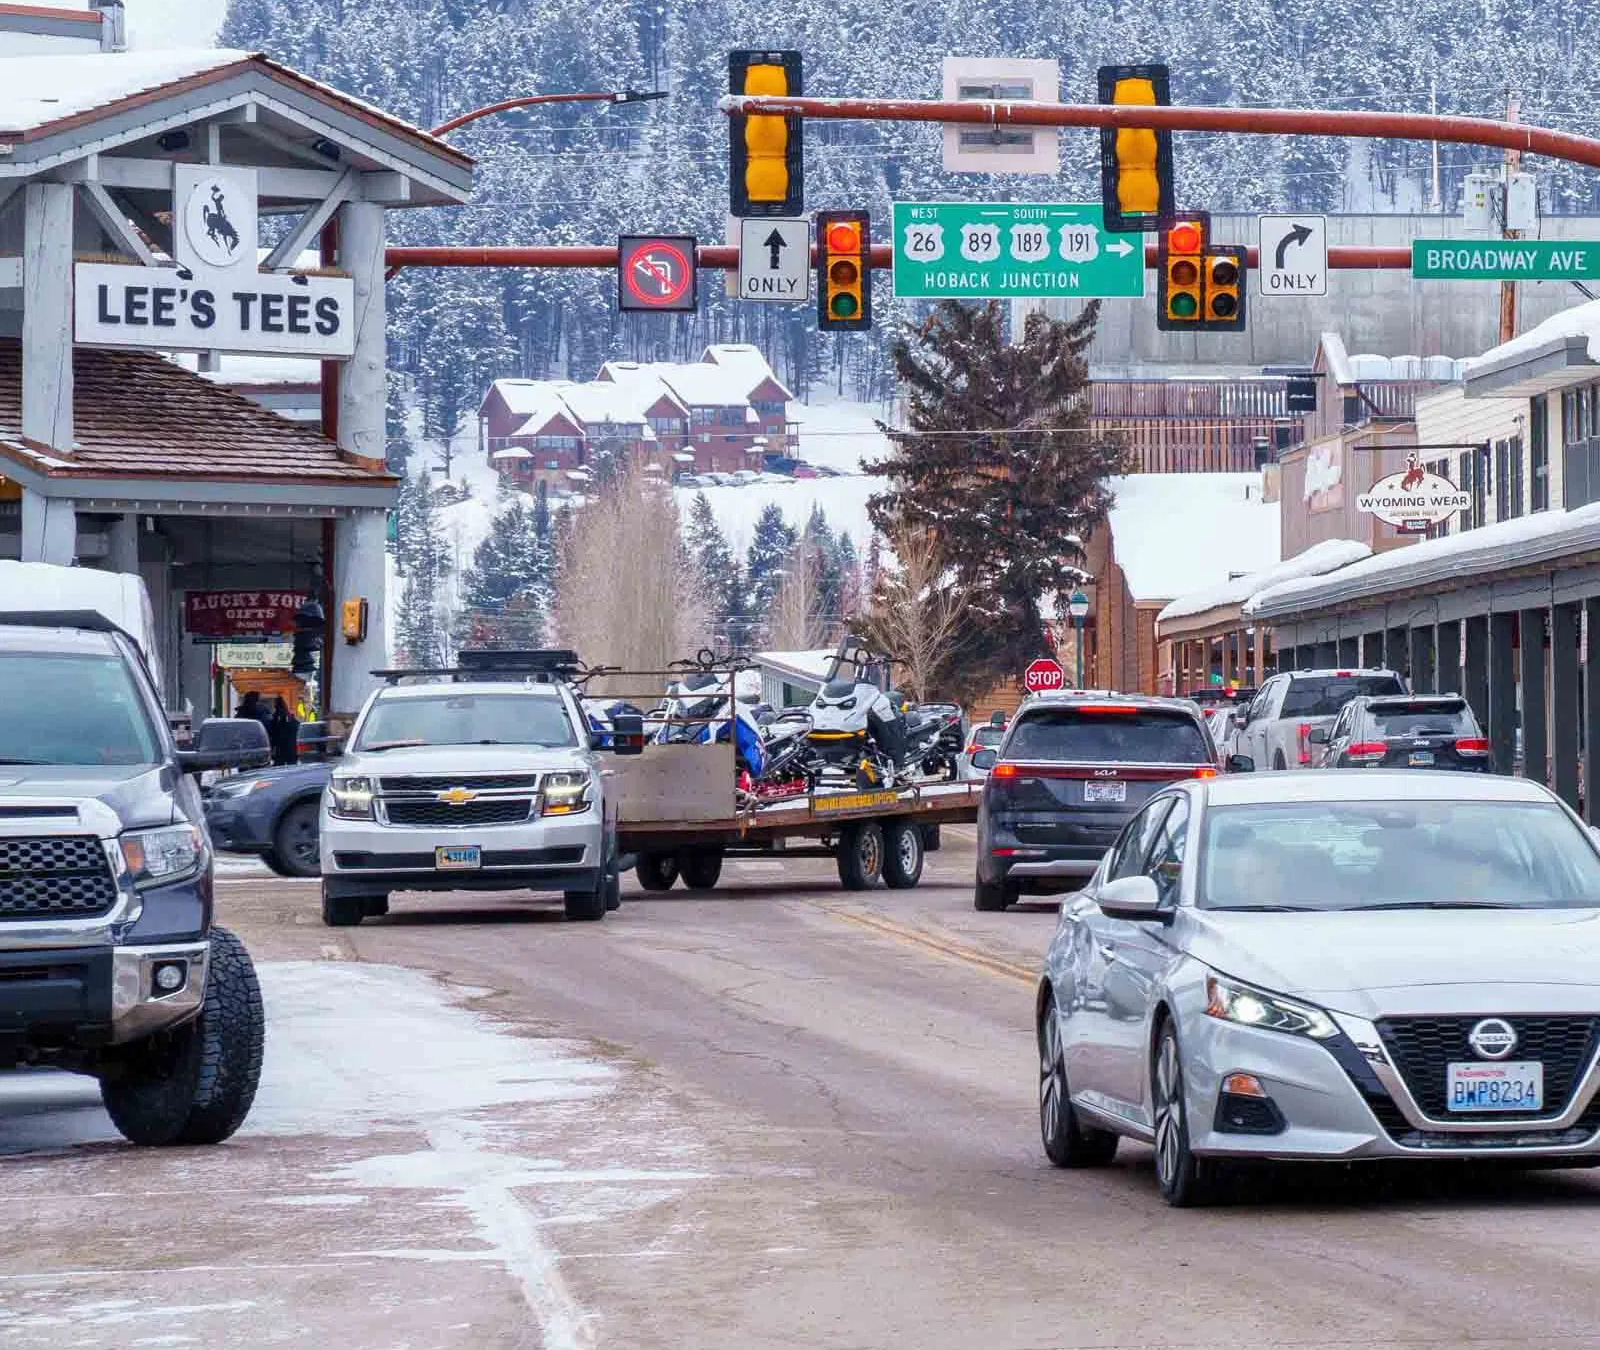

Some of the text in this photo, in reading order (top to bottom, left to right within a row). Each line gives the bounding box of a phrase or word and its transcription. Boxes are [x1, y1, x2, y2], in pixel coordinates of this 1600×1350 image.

[911, 208, 1048, 219] WEST SOUTH
[912, 232, 1090, 252] 26 89 189 191
[1427, 249, 1588, 272] BROADWAY AVE
[748, 277, 799, 294] ONLY
[924, 272, 1080, 289] HOBACK JUNCTION
[1270, 273, 1317, 290] ONLY
[98, 284, 340, 336] LEE'S TEES
[1360, 496, 1467, 508] WYOMING WEAR
[192, 592, 308, 610] LUCKY YOU
[226, 608, 276, 618] GIFTS
[1028, 670, 1061, 686] STOP
[1475, 1035, 1512, 1043] NISSAN
